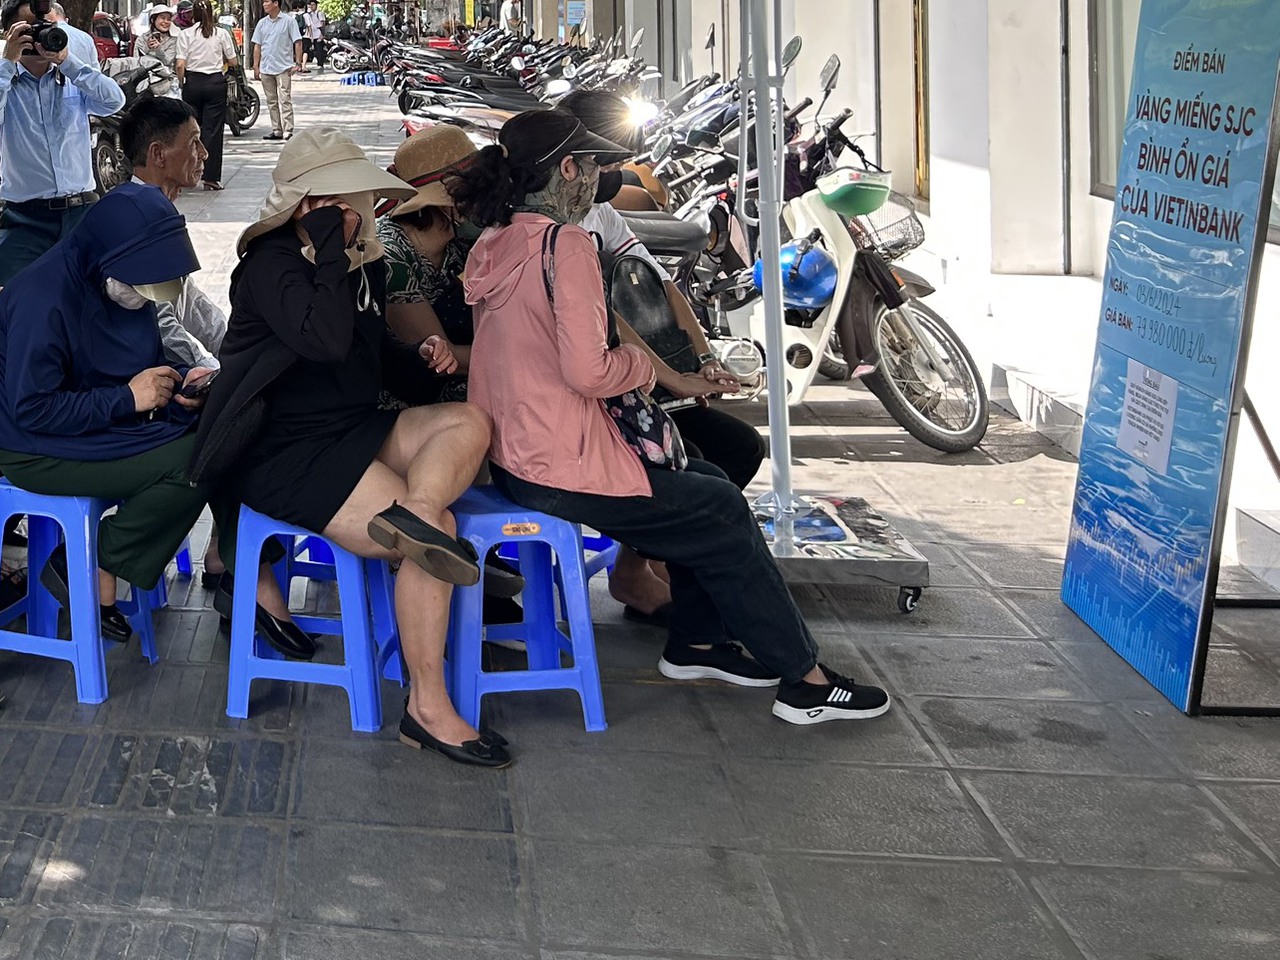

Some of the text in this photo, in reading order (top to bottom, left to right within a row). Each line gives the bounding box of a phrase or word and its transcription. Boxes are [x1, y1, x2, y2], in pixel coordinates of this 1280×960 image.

[1173, 43, 1226, 74] ĐIỂM BÁN
[1136, 88, 1256, 137] VÀNG MIẾNG SJC
[1137, 136, 1231, 189] BÌNH ỔN GIÁ
[1121, 178, 1245, 244] CỦA VIETINBANK
